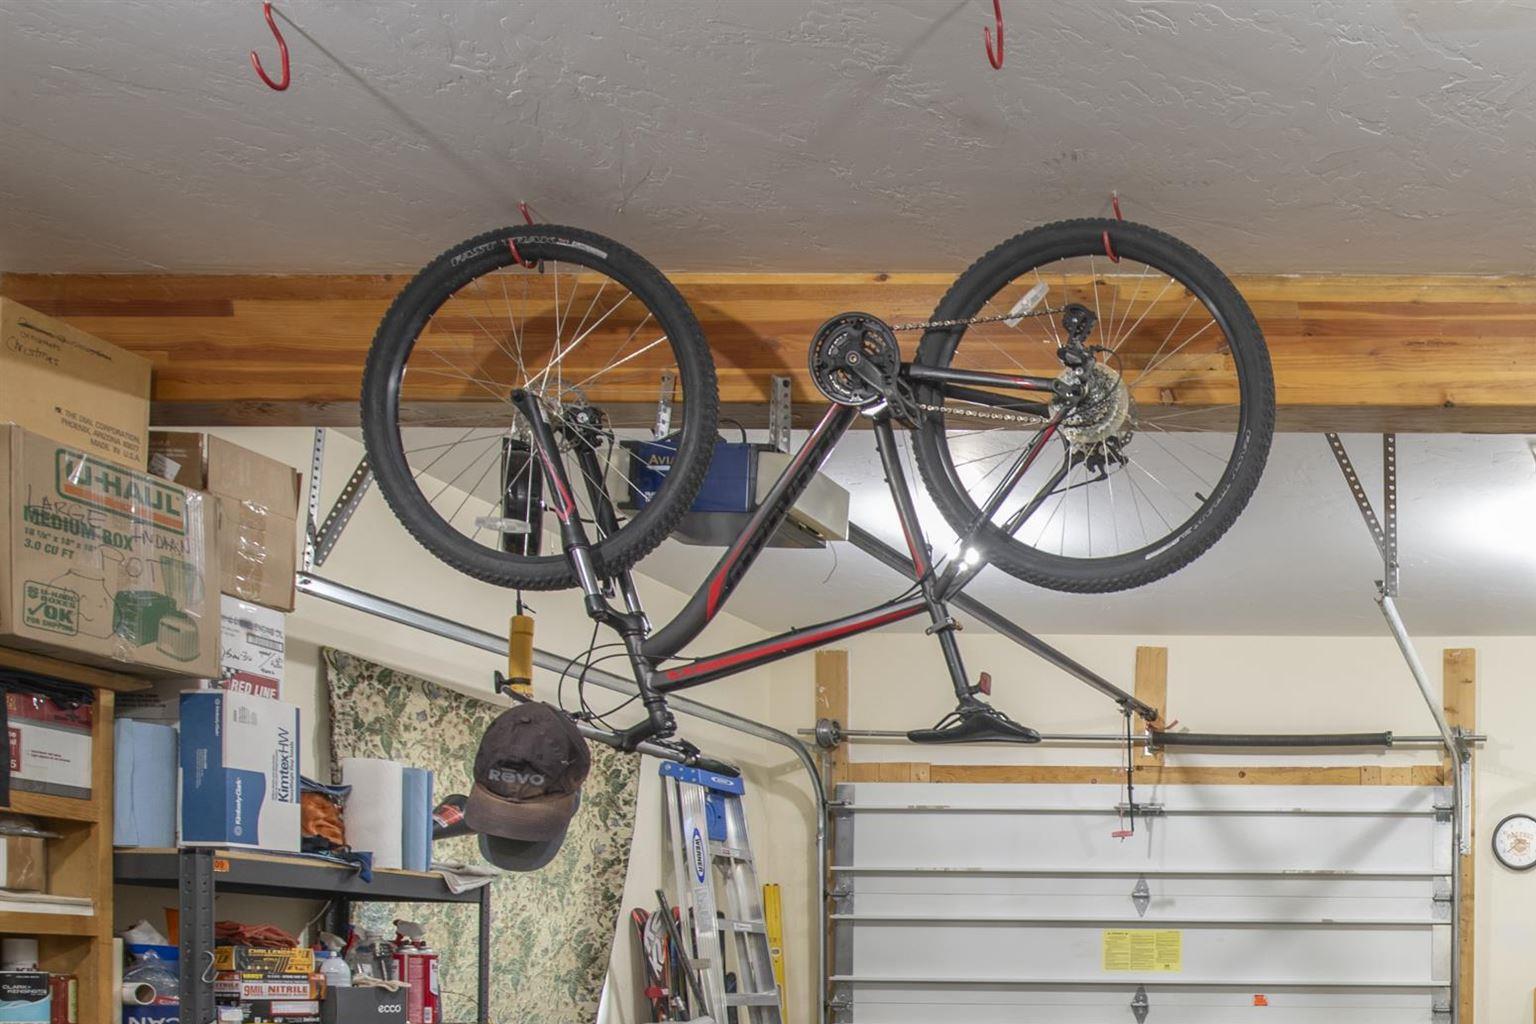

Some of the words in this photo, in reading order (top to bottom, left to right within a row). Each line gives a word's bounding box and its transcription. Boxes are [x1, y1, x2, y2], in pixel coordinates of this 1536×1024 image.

[65, 458, 181, 516] U-HAUL
[102, 529, 134, 551] BOX
[43, 603, 74, 625] OK
[231, 679, 252, 695] RED
[254, 684, 277, 699] LINE
[268, 985, 308, 995] NITRILE
[378, 1004, 402, 1013] ecco
